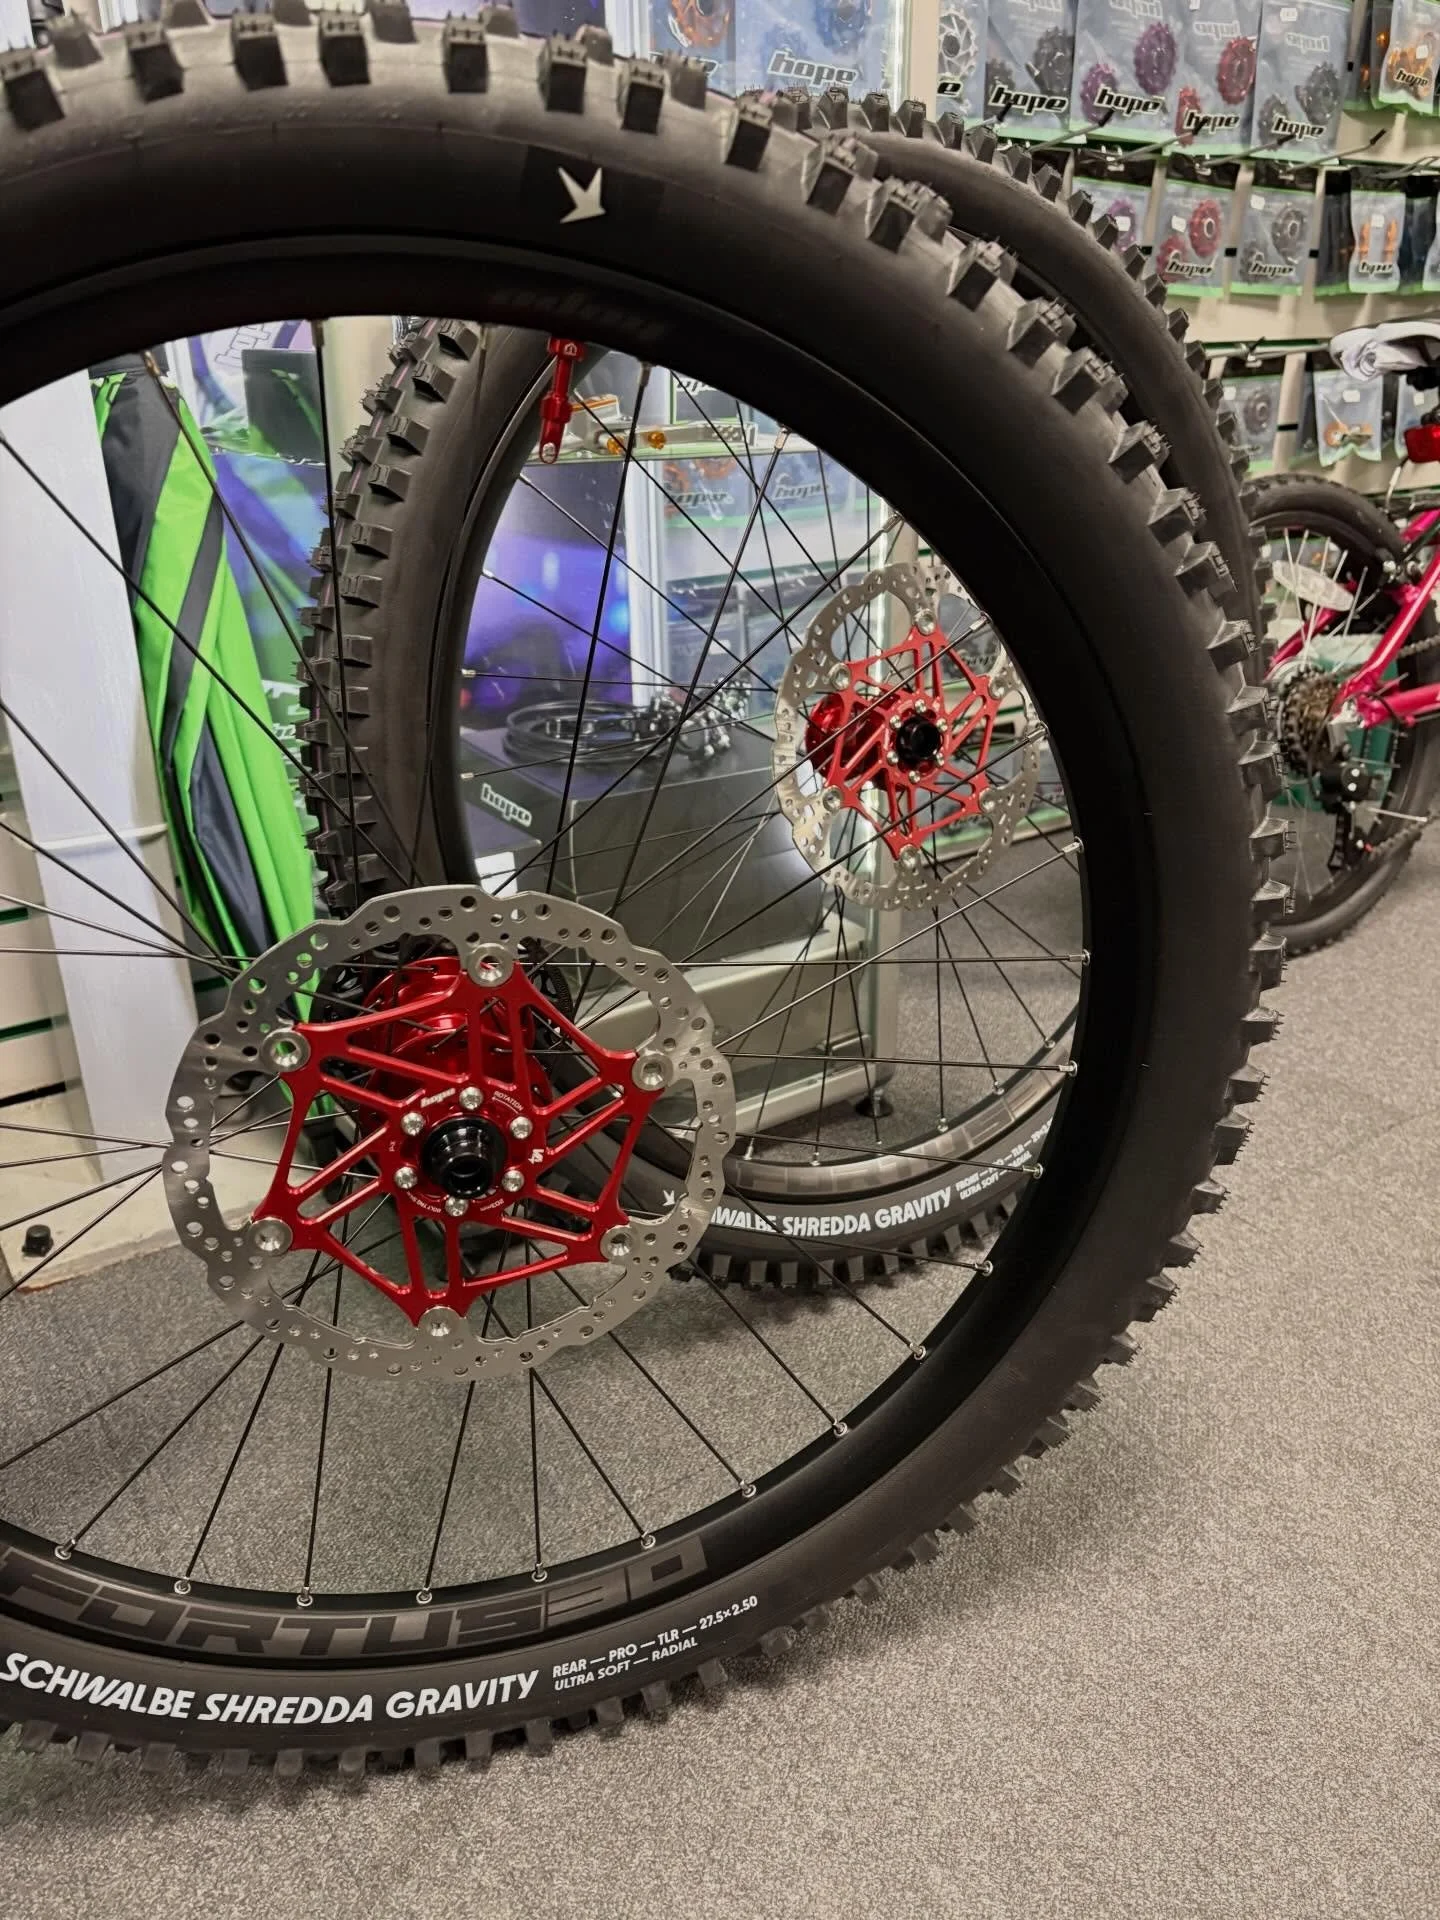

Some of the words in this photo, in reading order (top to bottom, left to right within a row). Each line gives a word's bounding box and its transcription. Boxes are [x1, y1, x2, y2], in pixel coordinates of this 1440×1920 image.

[768, 49, 858, 87] hope
[989, 85, 1068, 115] hope
[1095, 87, 1164, 118] hope
[1272, 116, 1325, 140] hope
[481, 783, 532, 827] hope
[494, 1091, 524, 1112] ROTATION
[955, 1173, 980, 1191] FRONT
[960, 1185, 982, 1200] ULTRA
[783, 1211, 871, 1237] SHREDDA
[875, 1186, 951, 1229] GRAVITY
[552, 1658, 587, 1678] REAR
[608, 1644, 638, 1662] PRO
[657, 1628, 679, 1646] TLR
[554, 1674, 595, 1691] ULTRA
[597, 1660, 631, 1680] SOFT
[652, 1636, 698, 1662] RADIAL
[0, 1652, 195, 1719] SCHWALBE
[198, 1693, 374, 1724] SHREDDA
[386, 1669, 539, 1719] GRAVITY
